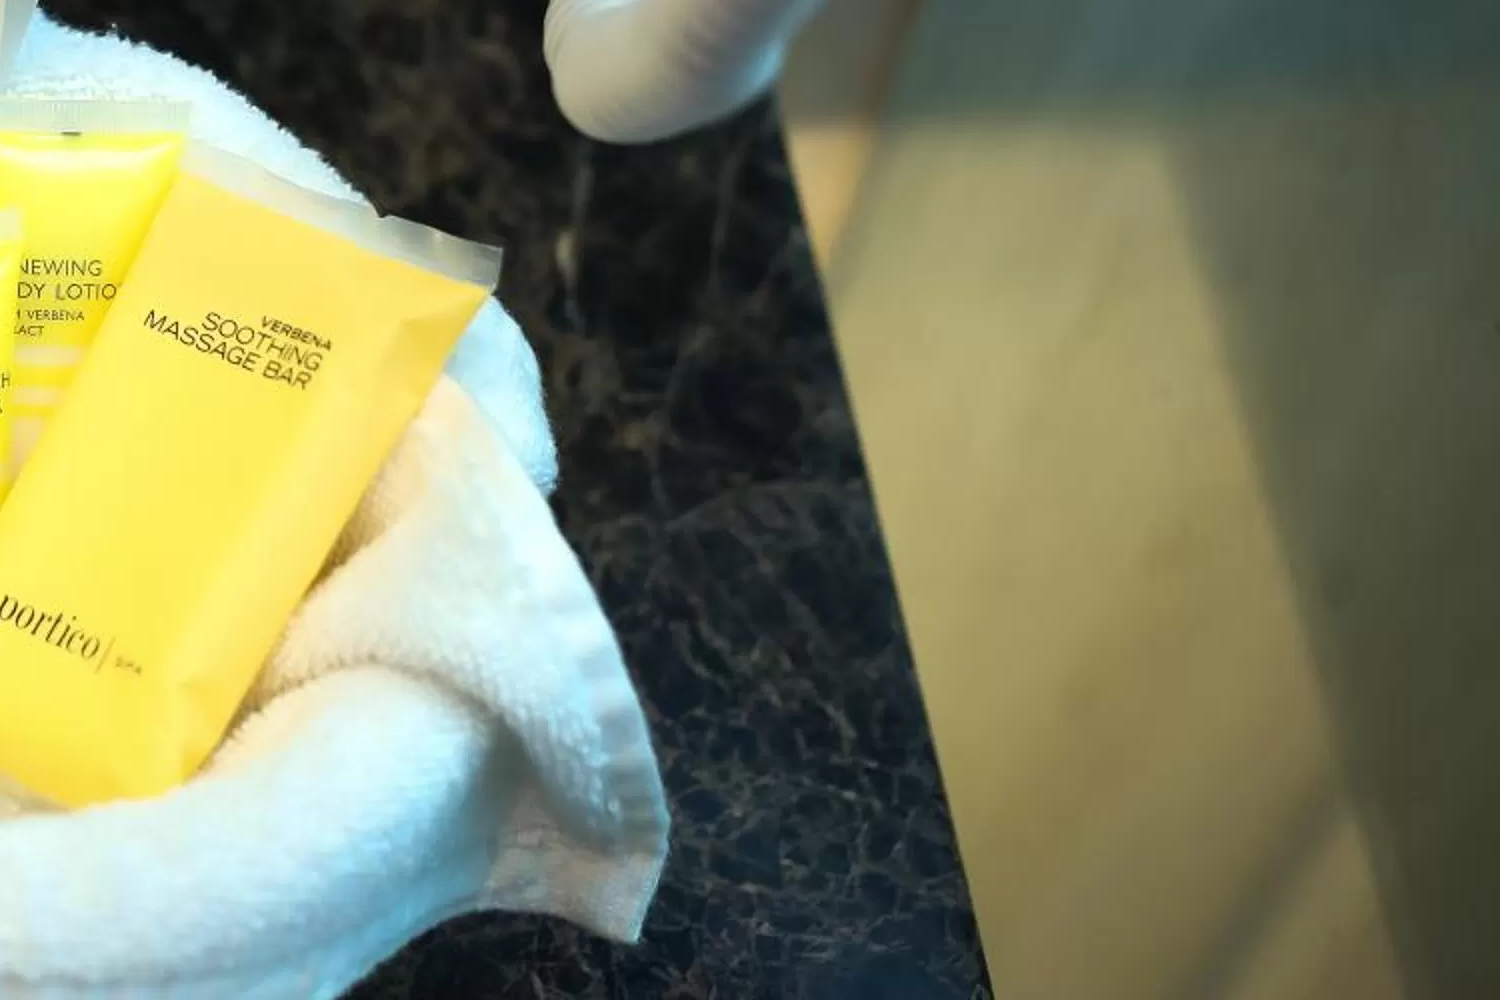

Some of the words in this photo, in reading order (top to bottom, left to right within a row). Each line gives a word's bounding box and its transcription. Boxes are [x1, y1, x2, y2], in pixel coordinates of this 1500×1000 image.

[55, 282, 121, 301] LOTIO
[27, 308, 85, 321] VERBENA
[260, 314, 332, 352] VERBENA
[143, 308, 261, 372] MASSAGE
[262, 359, 313, 391] BAR
[200, 310, 323, 371] SOOTHING
